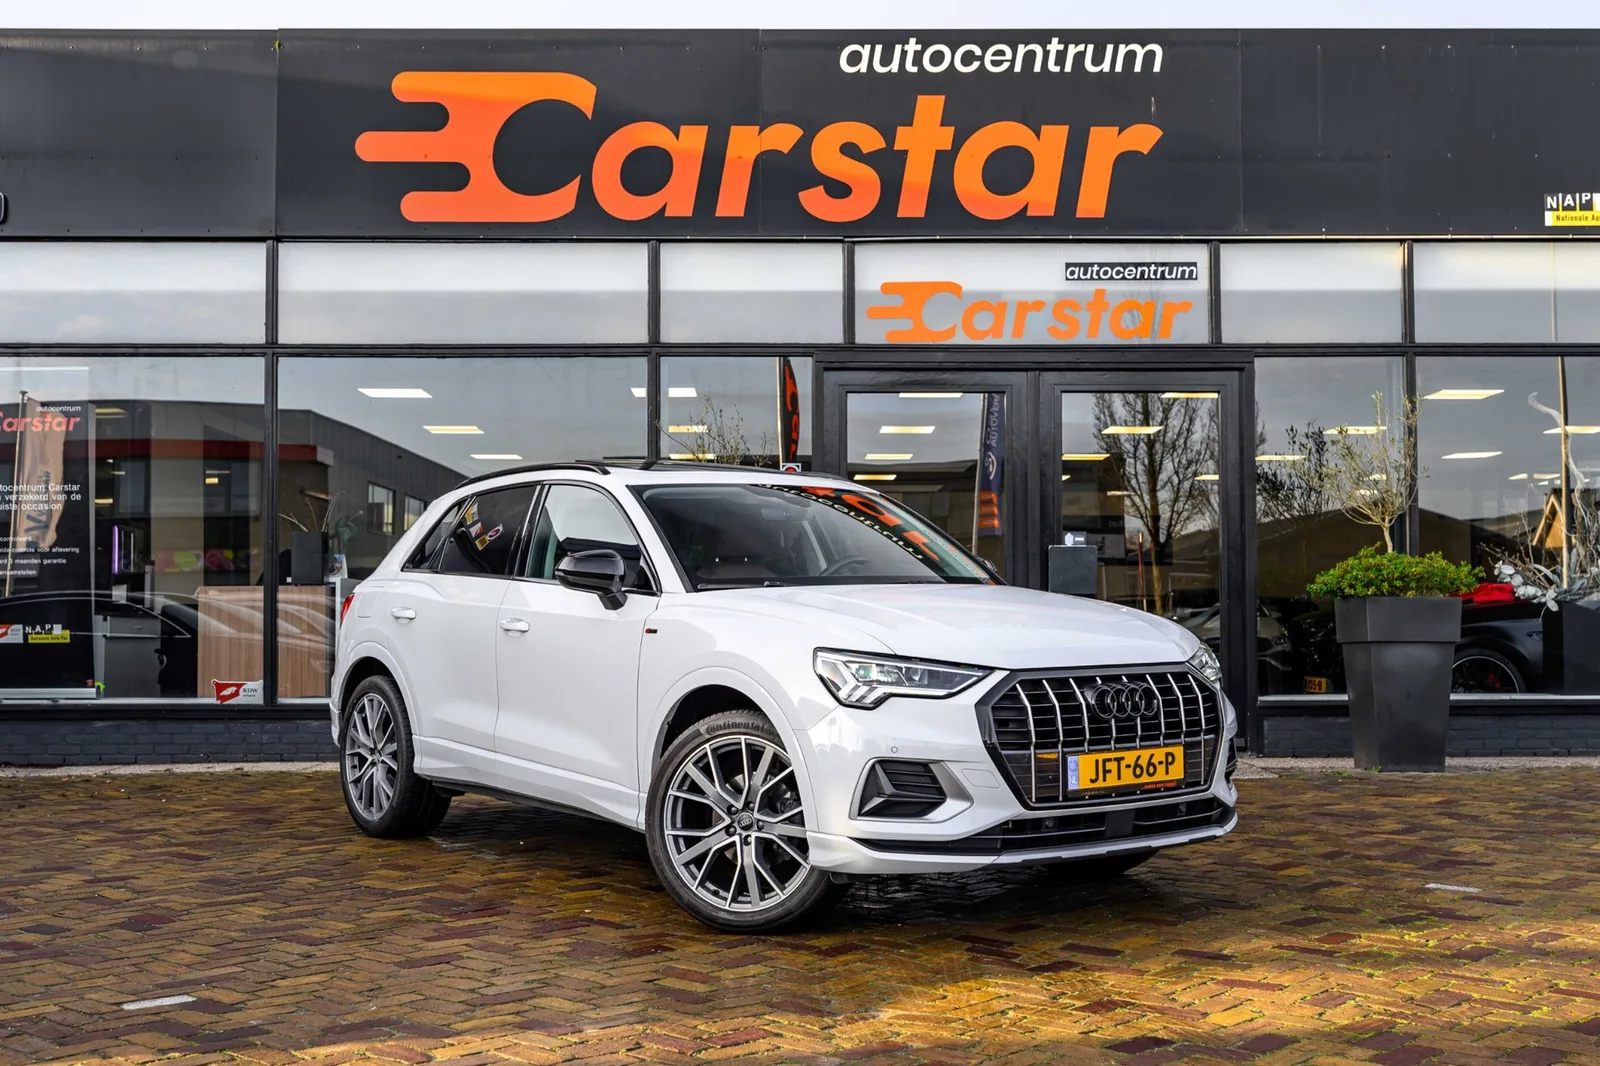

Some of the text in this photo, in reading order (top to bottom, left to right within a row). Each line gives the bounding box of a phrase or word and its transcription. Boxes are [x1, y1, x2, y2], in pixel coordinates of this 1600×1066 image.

[839, 37, 1163, 74] autocentrum
[355, 71, 1163, 223] Carstar
[1556, 214, 1589, 222] Nationale
[1066, 264, 1197, 280] autocentrum
[866, 281, 1194, 343] Carstar
[0, 411, 81, 432] arstar
[49, 483, 81, 491] Carstar
[705, 720, 766, 736] Continental
[1089, 751, 1176, 784] JFT-66-P
